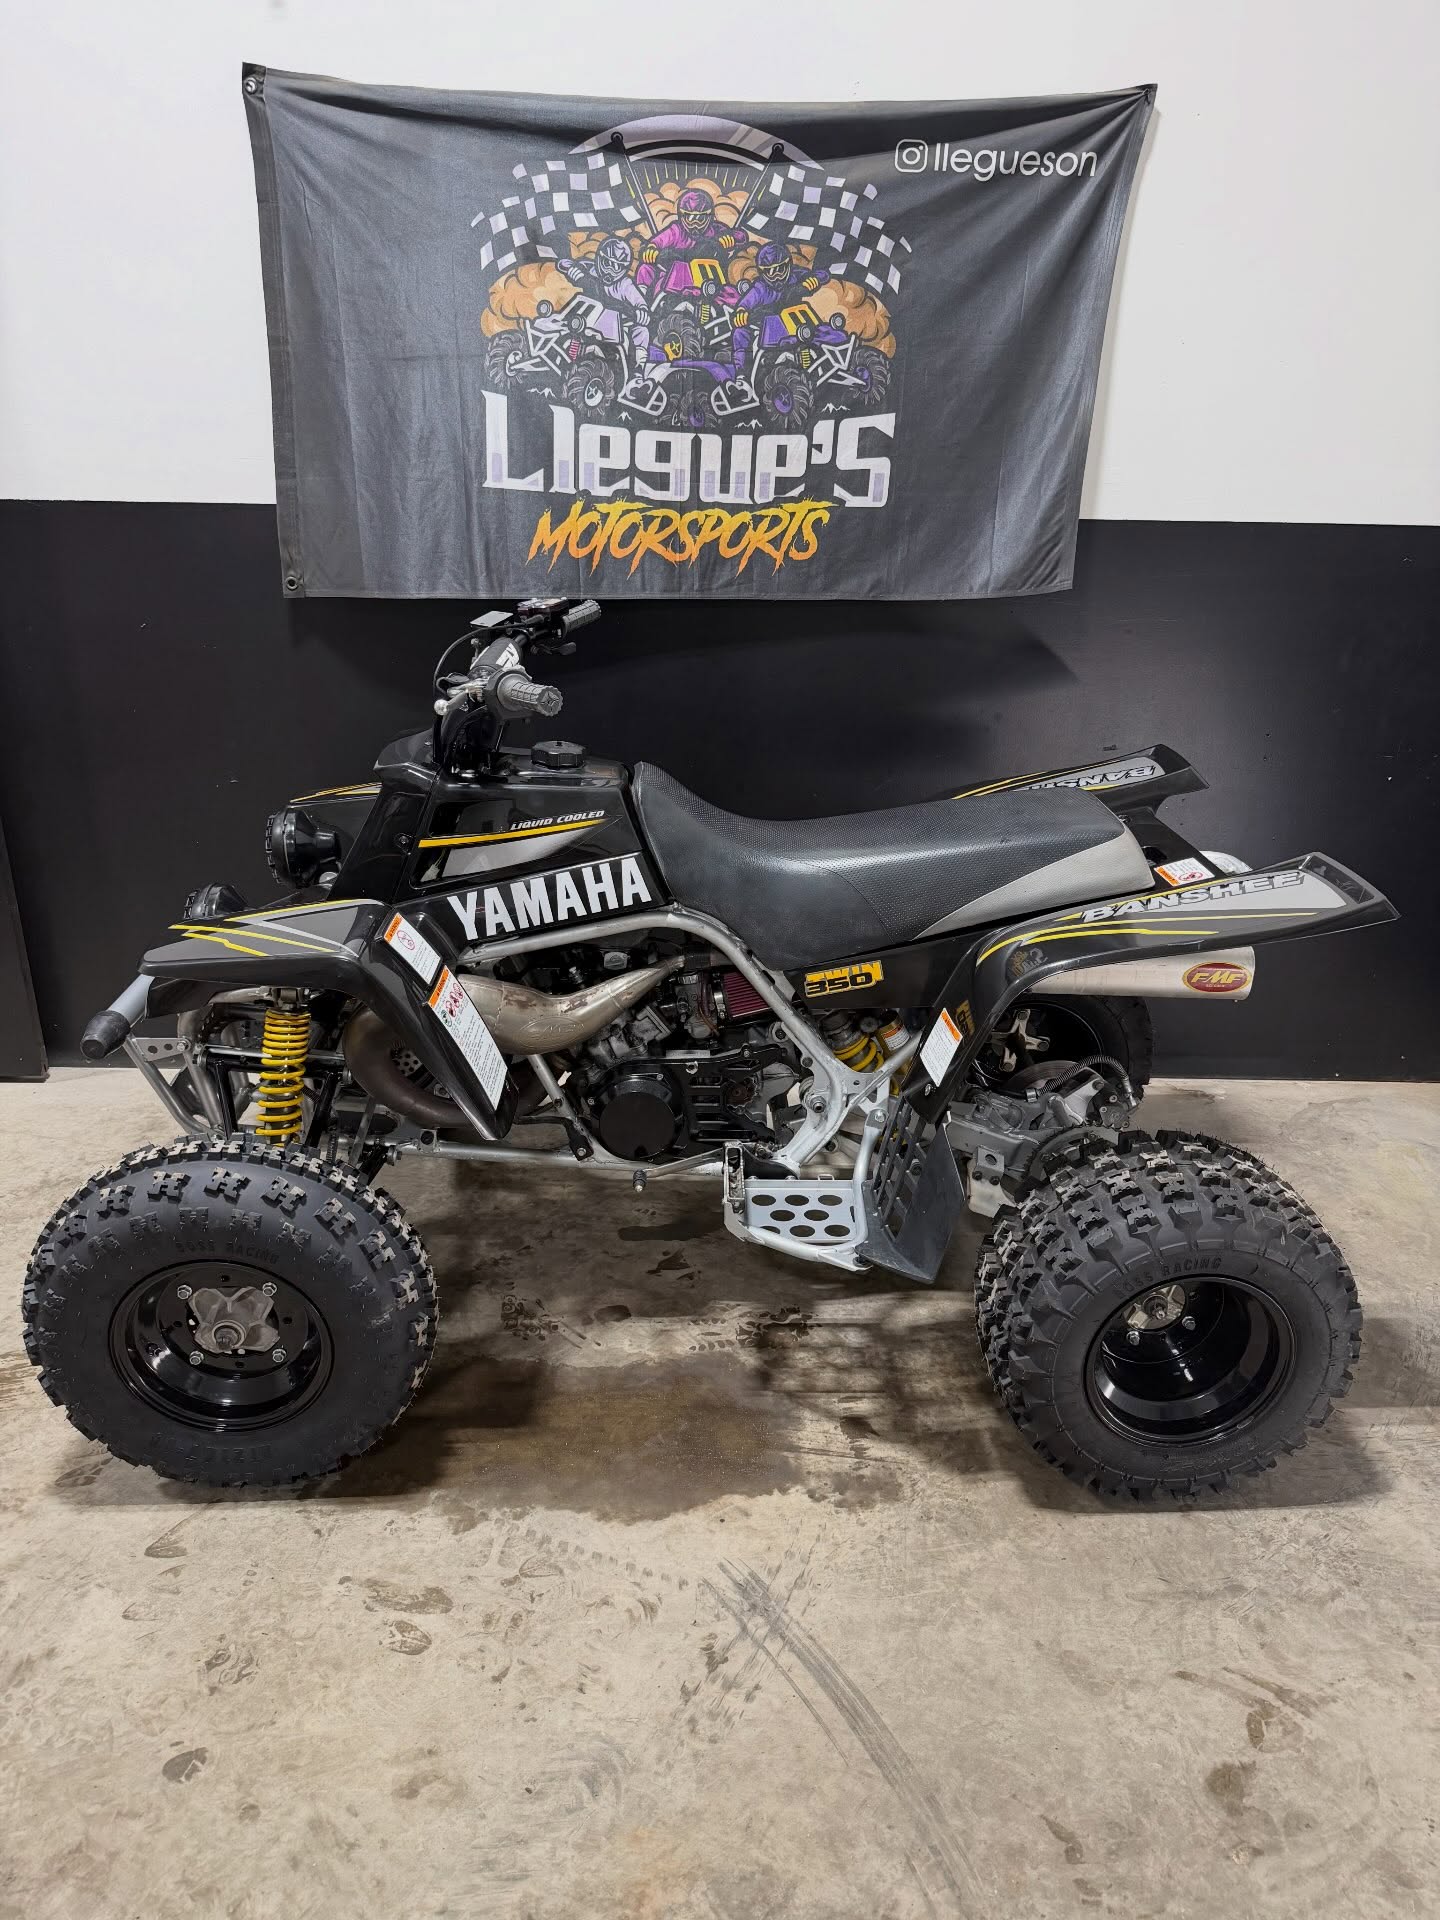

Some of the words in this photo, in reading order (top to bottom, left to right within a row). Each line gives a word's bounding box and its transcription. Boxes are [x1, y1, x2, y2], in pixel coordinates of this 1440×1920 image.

[933, 142, 1098, 182] llegueson
[525, 498, 837, 578] MOTORSPORTS
[510, 818, 553, 831] LIQUID
[556, 809, 605, 823] COOLED
[446, 856, 653, 941] YAMAHA
[1081, 870, 1305, 924] BANSHEE
[804, 971, 878, 998] 350
[805, 960, 884, 984] TWIN
[1190, 970, 1245, 985] FMF
[1160, 1257, 1222, 1276] RACING
